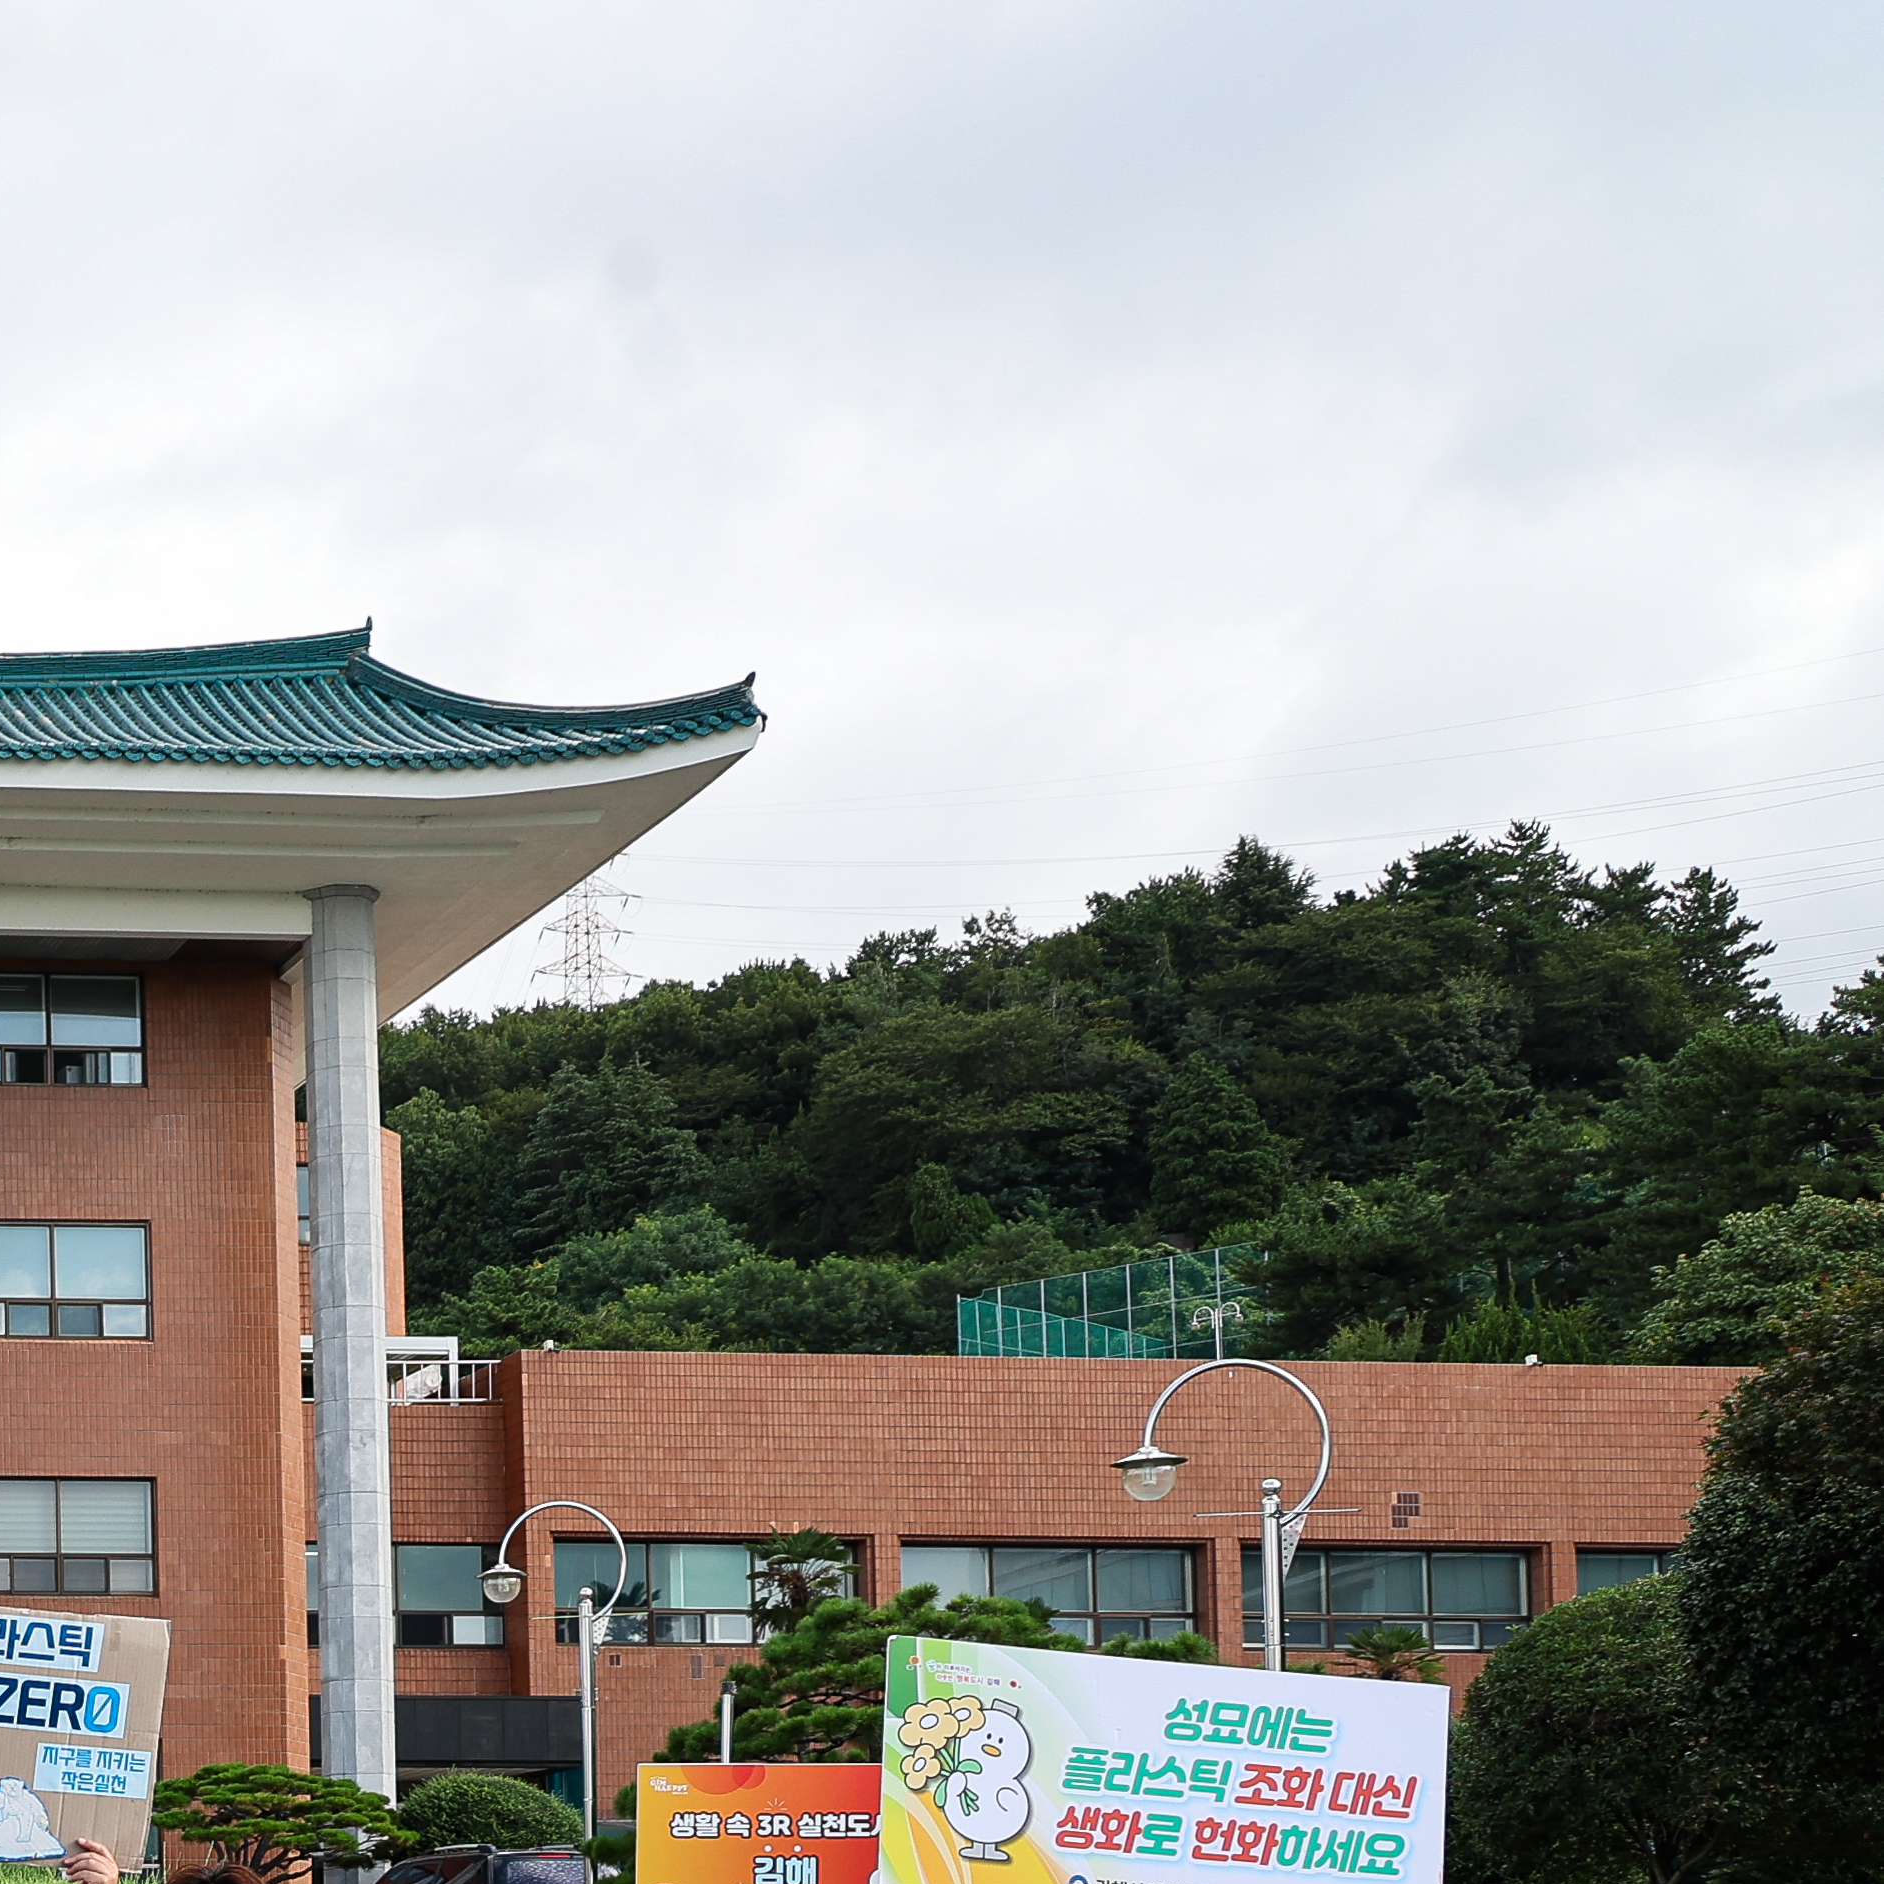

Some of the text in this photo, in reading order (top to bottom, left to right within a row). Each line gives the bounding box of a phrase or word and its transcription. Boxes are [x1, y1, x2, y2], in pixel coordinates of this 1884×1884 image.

[1163, 1697, 1334, 1753] 성묘에는
[41, 1745, 146, 1773] 지구를 지키는
[60, 1770, 127, 1795] 작은실천
[1062, 1746, 1418, 1819] 플라스틱 조화 대신
[670, 1813, 721, 1838] 생활
[725, 1813, 751, 1838] 속
[757, 1814, 792, 1837] 3R
[1054, 1805, 1406, 1876] 생화로 헌화하세요
